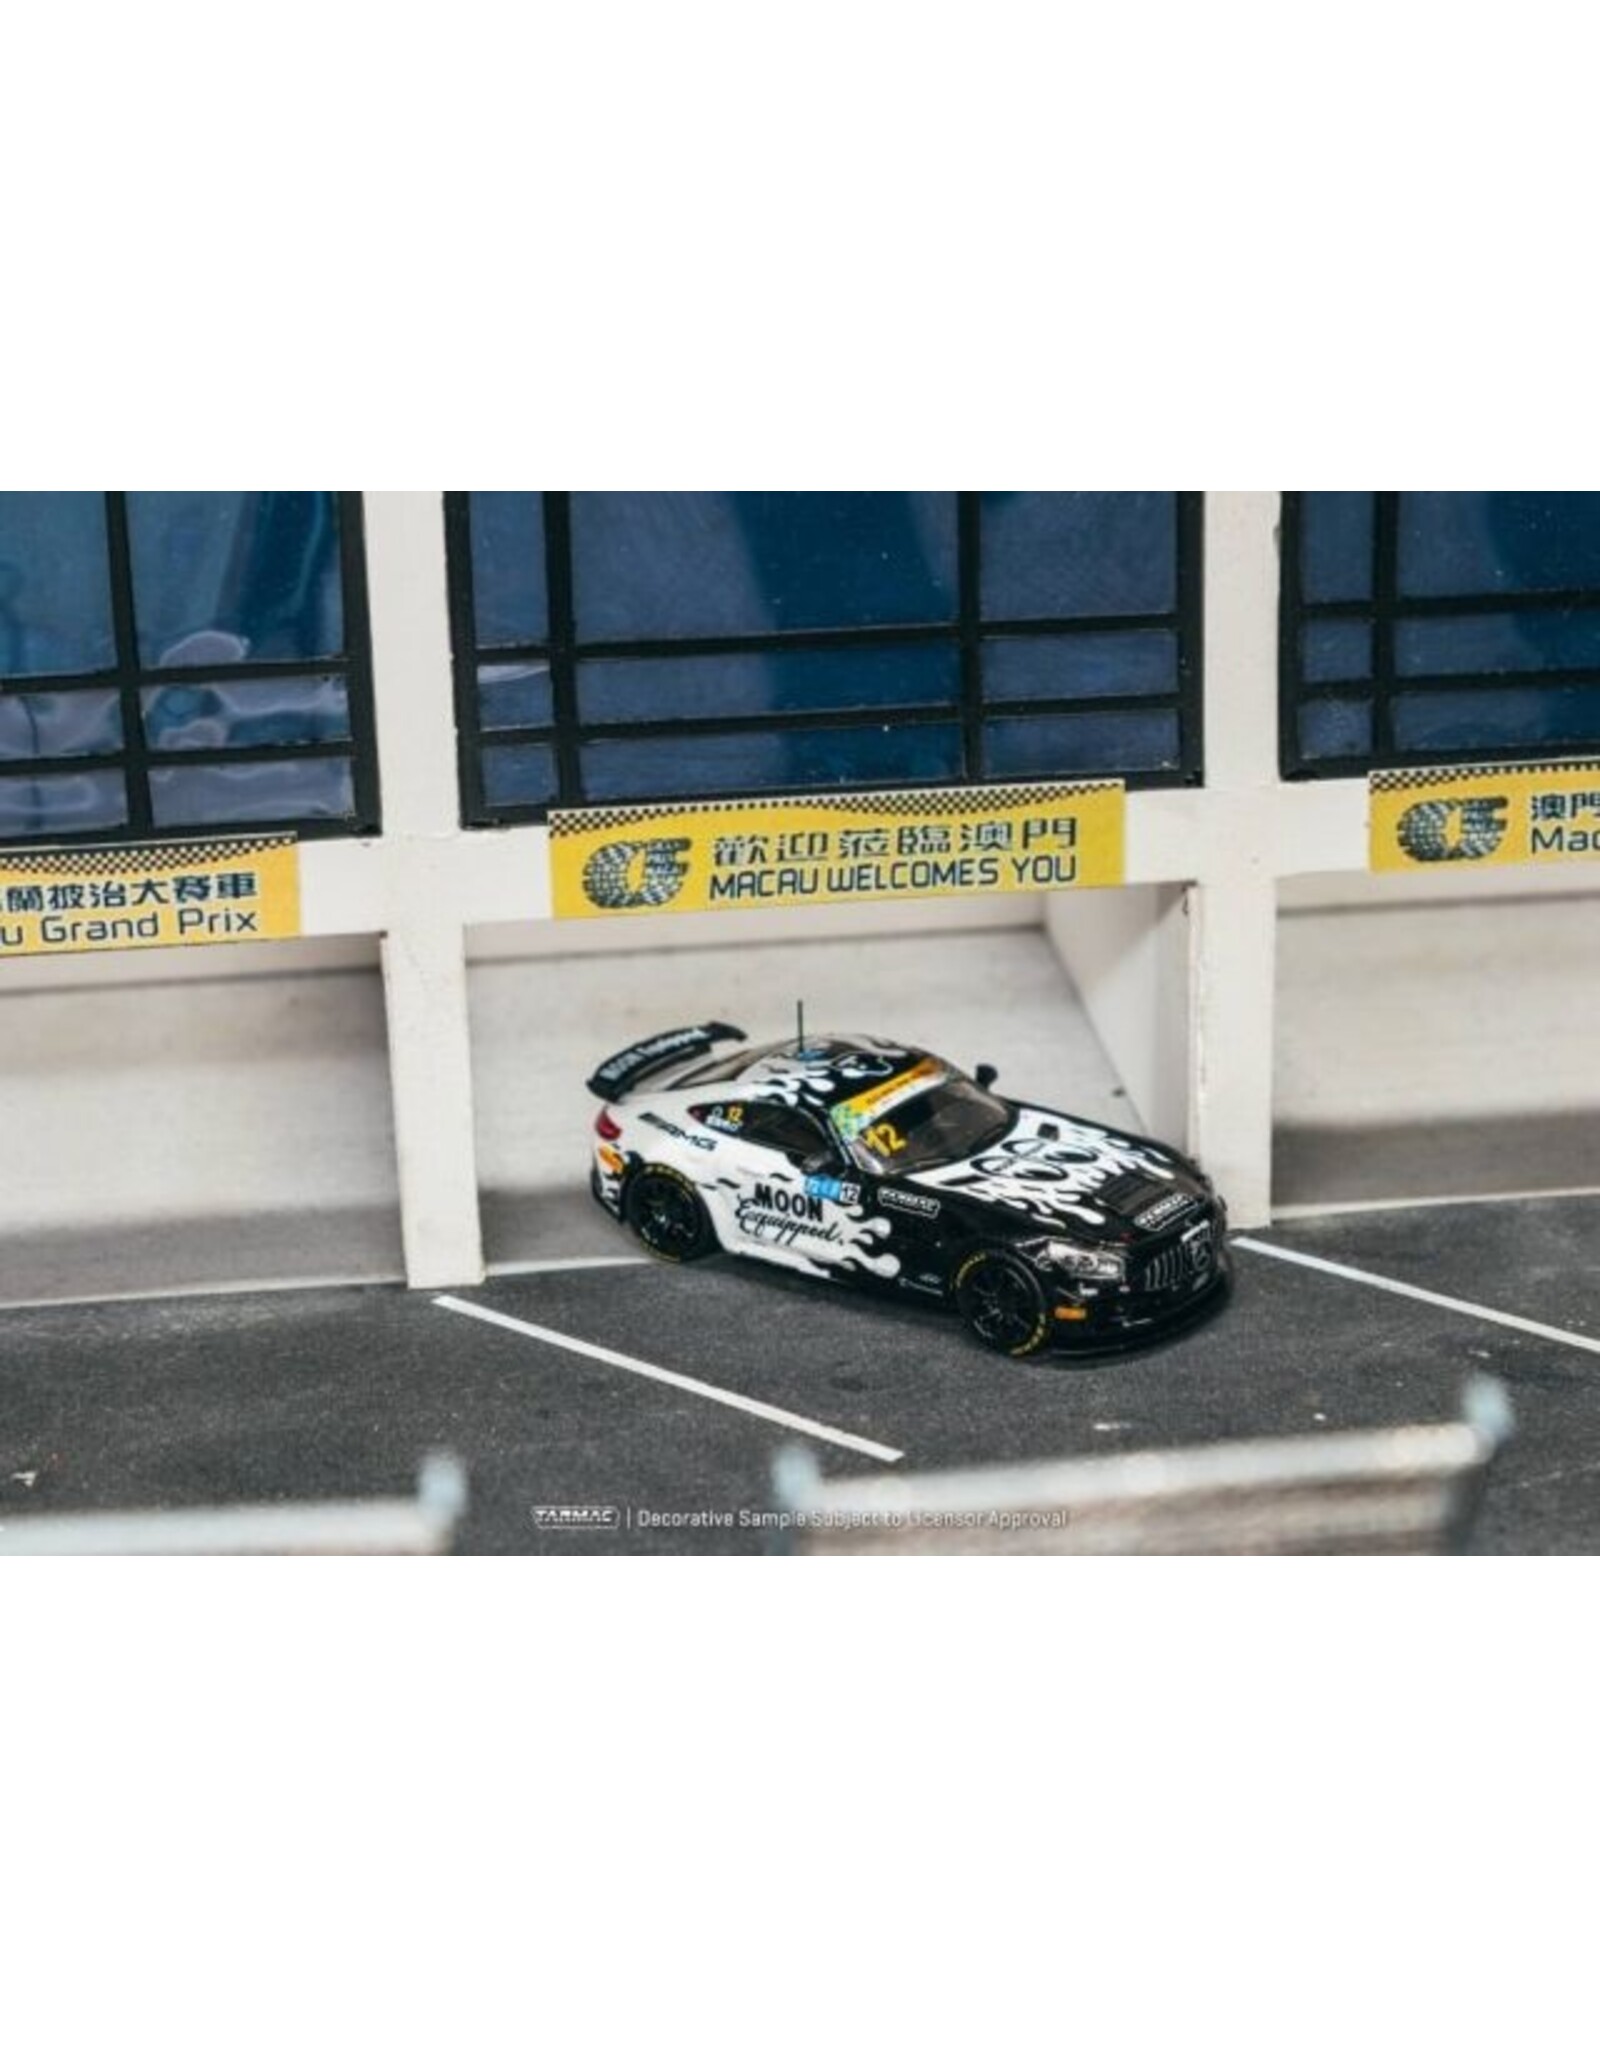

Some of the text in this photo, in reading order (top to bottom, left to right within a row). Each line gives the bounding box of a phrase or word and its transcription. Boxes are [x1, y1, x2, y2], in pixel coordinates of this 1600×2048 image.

[709, 855, 1077, 900] MACAU WELCOMES YOU
[41, 911, 159, 944] Grand
[177, 906, 258, 935] Prix
[865, 1123, 907, 1157] 12
[754, 1182, 824, 1222] MOON
[842, 1185, 858, 1203] 12
